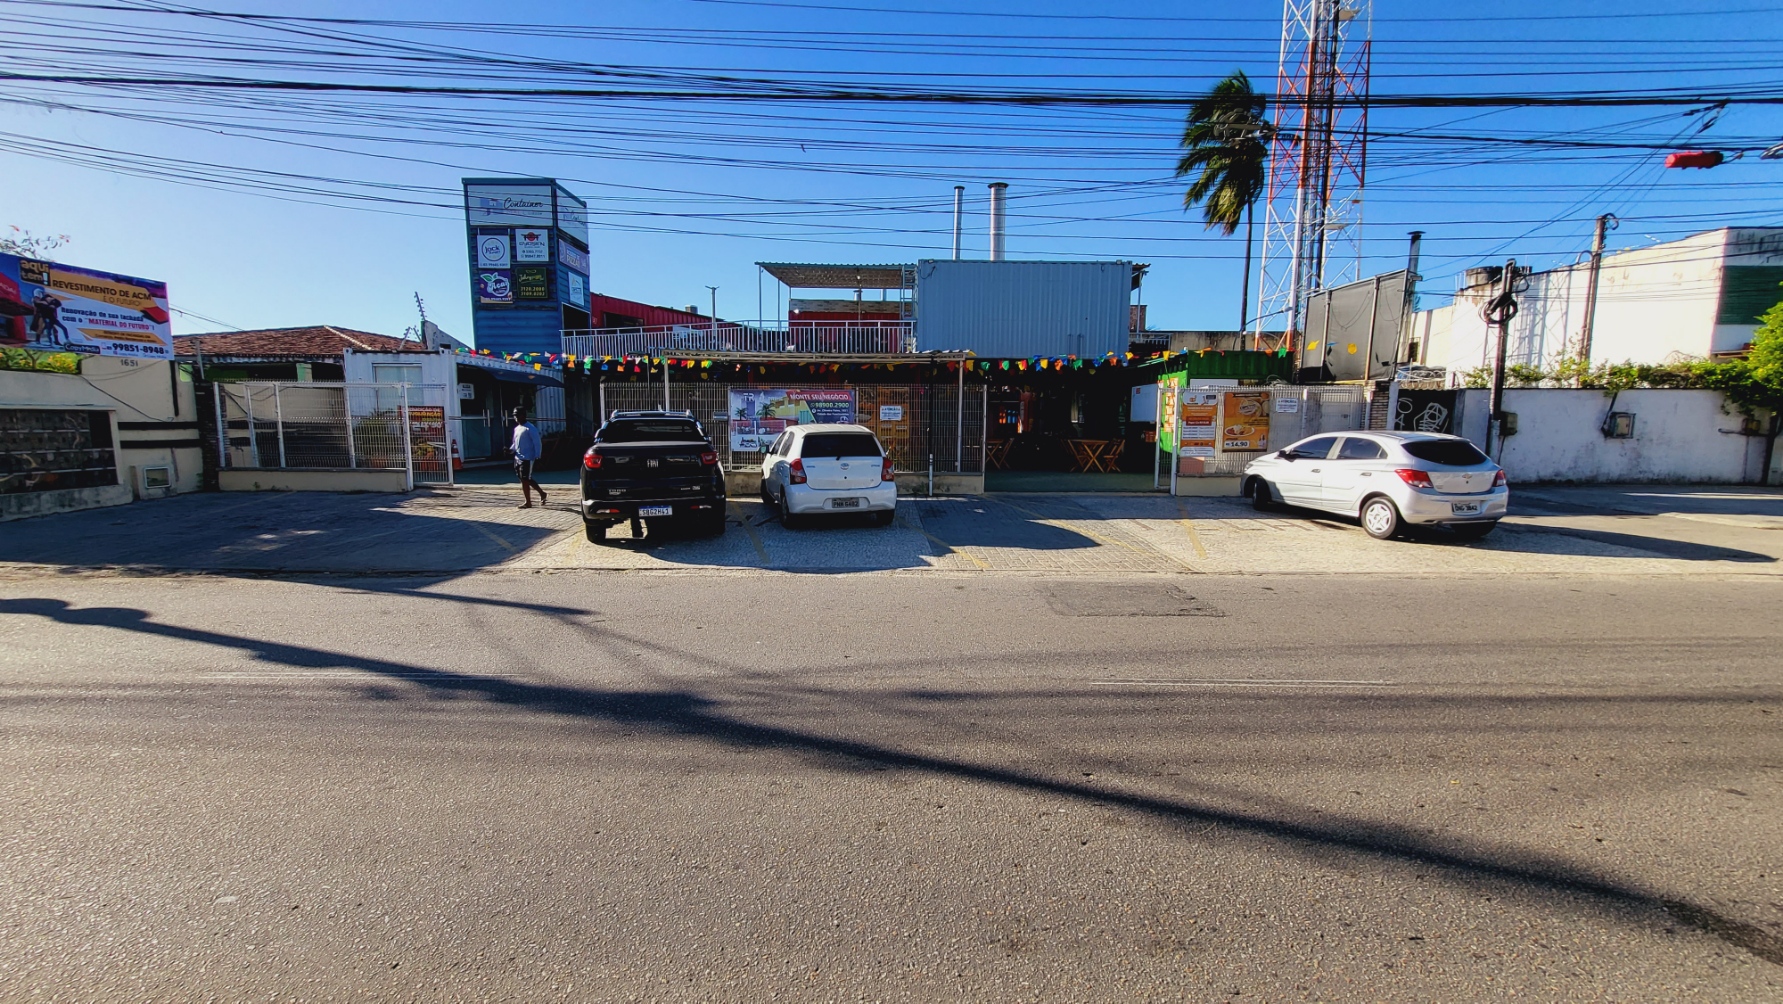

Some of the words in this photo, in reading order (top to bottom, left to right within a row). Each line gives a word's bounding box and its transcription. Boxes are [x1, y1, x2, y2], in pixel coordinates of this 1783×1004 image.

[504, 197, 544, 209] Container
[21, 260, 49, 273] aqui
[21, 271, 48, 285] tem!
[53, 279, 117, 296] REVESTIMENTO
[119, 289, 129, 297] DE
[132, 292, 151, 301] ACM
[61, 307, 97, 317] Renovação
[112, 343, 165, 355] 99851-8948
[120, 359, 139, 367] 1651
